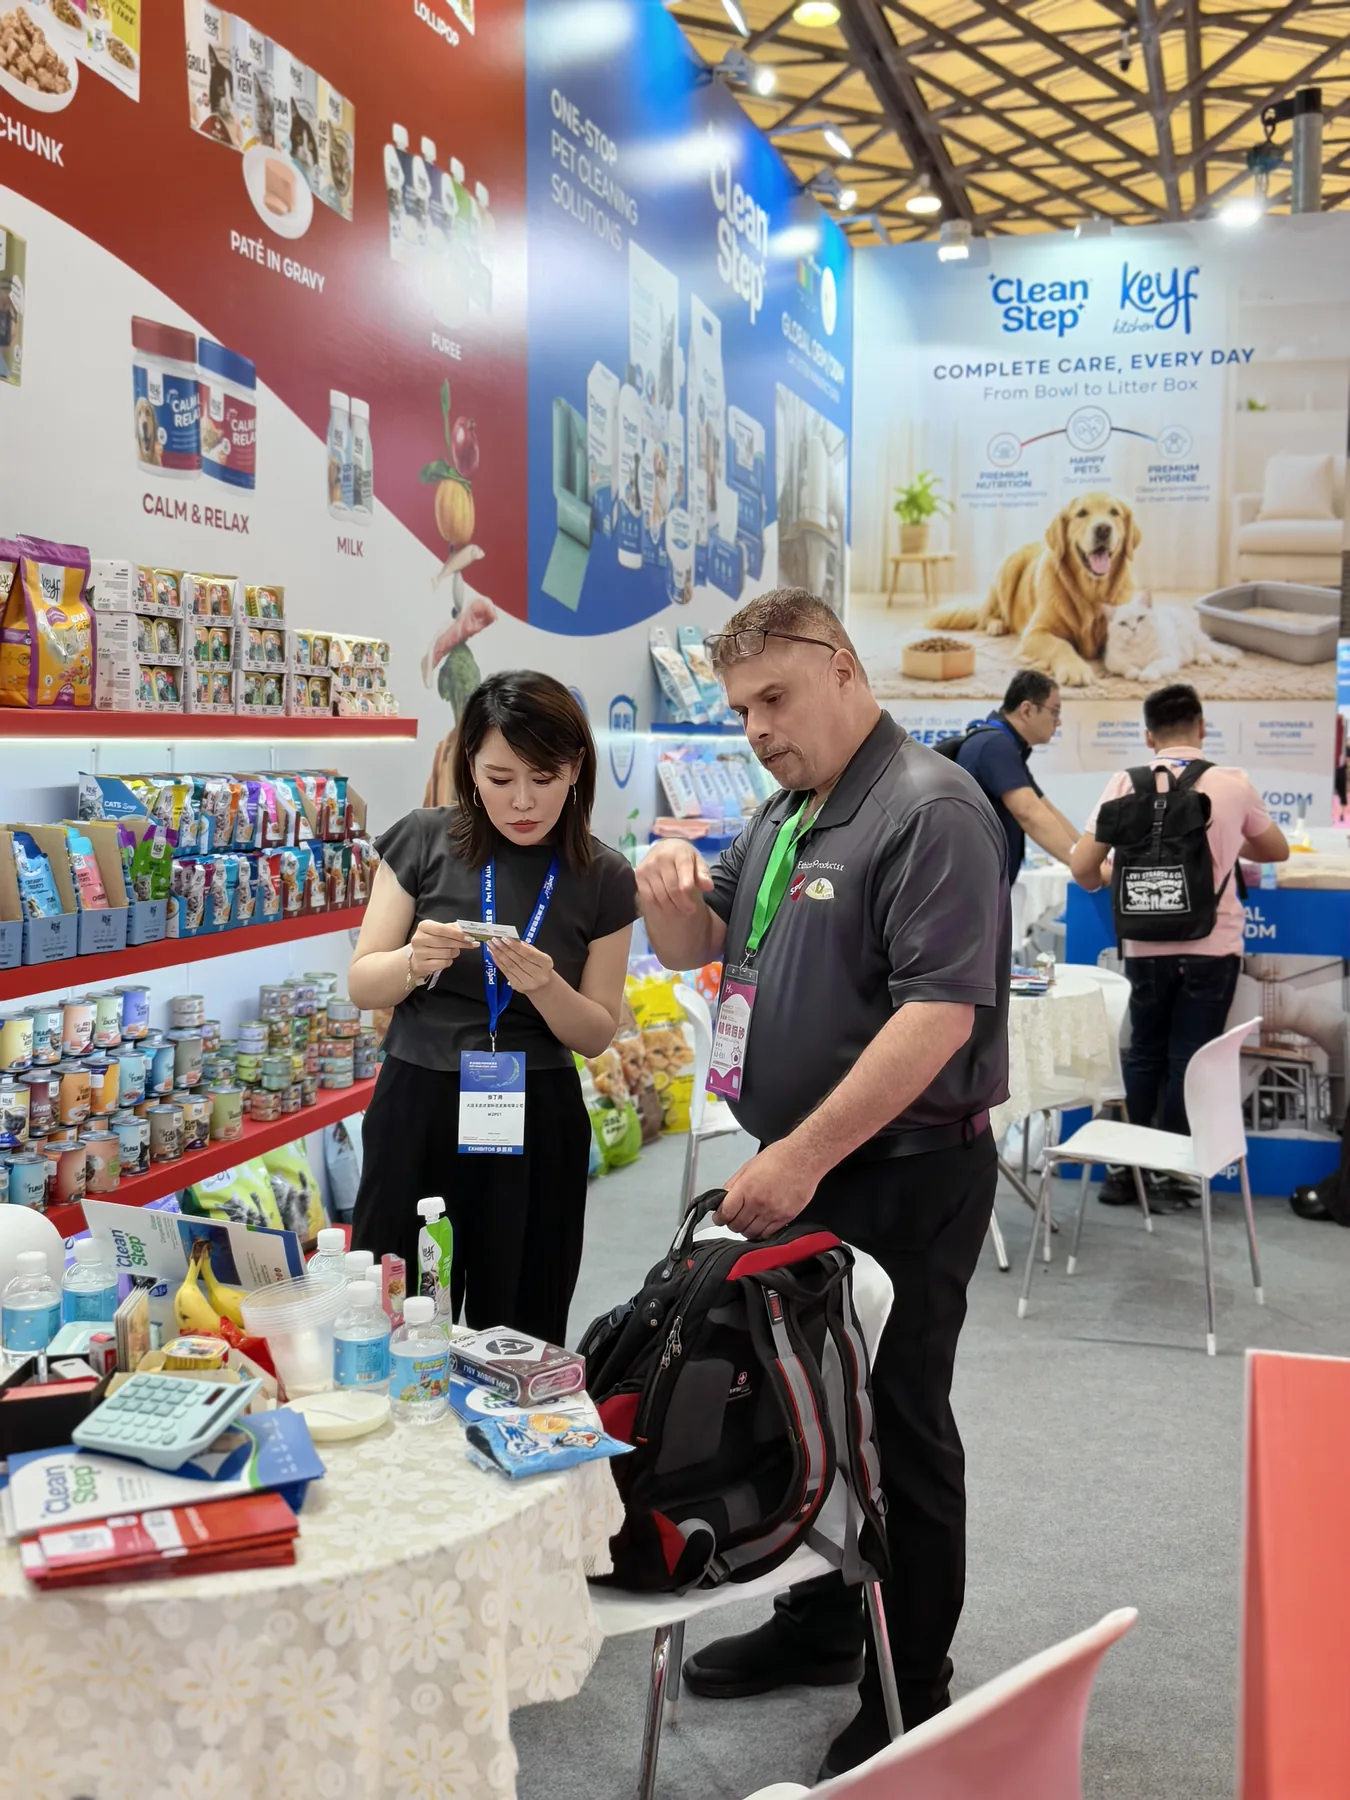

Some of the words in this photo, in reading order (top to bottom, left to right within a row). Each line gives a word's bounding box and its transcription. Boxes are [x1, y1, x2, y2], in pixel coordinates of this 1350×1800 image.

[414, 2, 459, 46] LOLLIPOP
[0, 112, 64, 167] CHUNK
[550, 88, 618, 165] ONE-STOP
[551, 130, 577, 174] PET
[578, 158, 638, 226] CLEANING
[551, 174, 622, 252] SOLUTIONS
[709, 156, 768, 257] Clean
[230, 230, 265, 264] PATÉ
[267, 248, 281, 272] IN
[283, 259, 325, 293] GRAVY
[717, 222, 764, 324] Step
[992, 277, 1089, 306] Clean
[1119, 262, 1201, 335] keyf
[1002, 306, 1079, 338] Step
[431, 331, 462, 361] PUREE
[933, 359, 1051, 380] COMPLETE
[1057, 355, 1123, 376] CARE,
[1130, 351, 1203, 370] EVERY
[1210, 347, 1256, 366] DAY
[983, 385, 1029, 402] From
[1034, 383, 1079, 399] Bowl
[1084, 382, 1102, 397] to
[1108, 379, 1159, 395] Litter
[1163, 376, 1199, 393] Box
[1069, 455, 1106, 466] HAPPY
[1074, 464, 1101, 475] PETS
[1147, 463, 1200, 474] PREMIUM
[976, 480, 1032, 490] NUTRITION
[979, 471, 1029, 481] PREMIUM
[1149, 472, 1198, 484] HYGIENE
[142, 493, 188, 523] CALM
[191, 508, 201, 525] &
[204, 506, 250, 534] RELAX
[337, 536, 364, 557] MILK
[41, 573, 61, 602] keyf
[1096, 731, 1141, 739] SOLUTIONS
[1258, 720, 1314, 729] SUSTAINABLE
[1269, 730, 1302, 739] FUTURE
[485, 891, 493, 903] Pet
[116, 1228, 133, 1268] Clean
[131, 1234, 149, 1267] Step
[463, 1364, 476, 1376] ASLI
[477, 1370, 496, 1385] BUBUK
[496, 1379, 511, 1391] KOPI
[45, 1464, 71, 1515] Clean
[73, 1464, 101, 1505] Step
